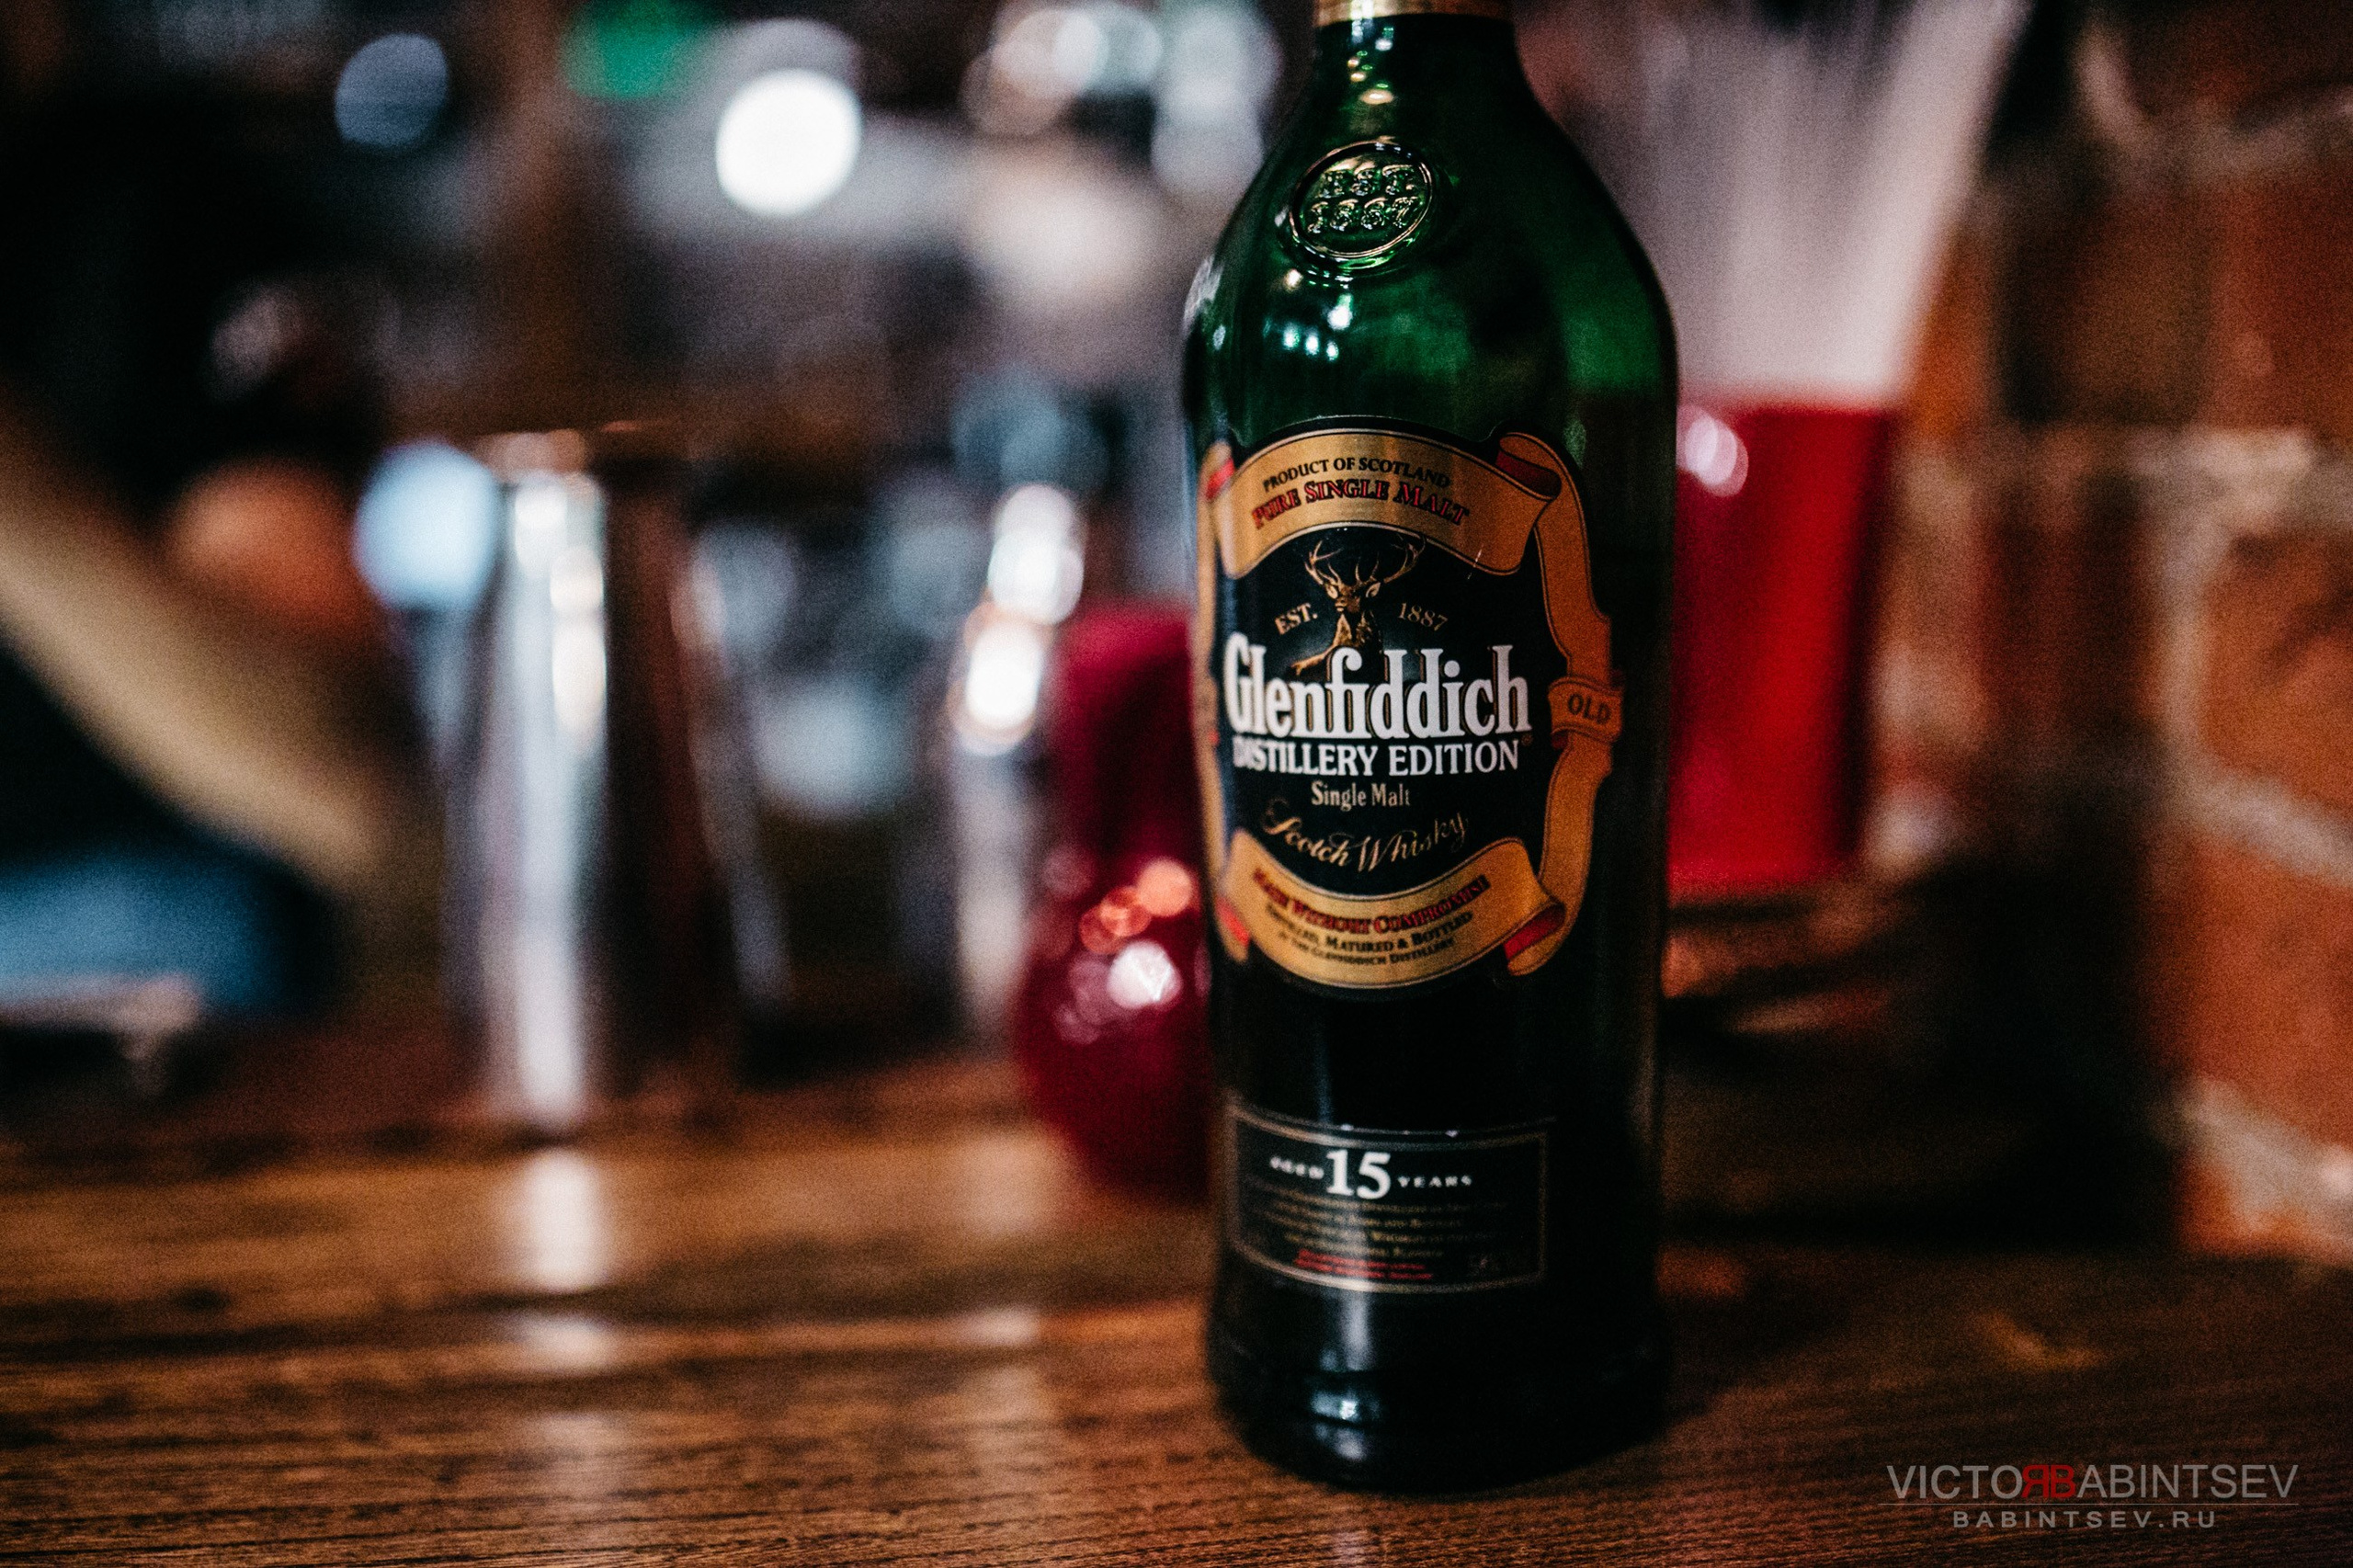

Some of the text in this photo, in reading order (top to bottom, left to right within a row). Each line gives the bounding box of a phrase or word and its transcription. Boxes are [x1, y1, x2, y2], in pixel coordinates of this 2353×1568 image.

[1263, 457, 1450, 493] PRODUCT OF SCOTLAND
[1251, 478, 1471, 530] PURE SINGLE MALT
[1274, 602, 1319, 636] EST.
[1397, 602, 1449, 632] 1887
[1222, 631, 1533, 740] Glenfiddich
[1566, 693, 1613, 726] OLD
[1232, 736, 1521, 778] DISTILLERY EDITION
[1311, 780, 1411, 812] Single Malt
[1261, 797, 1471, 873] Scotch Whisky
[1325, 1148, 1392, 1200] 15
[1396, 1175, 1472, 1188] YEARS
